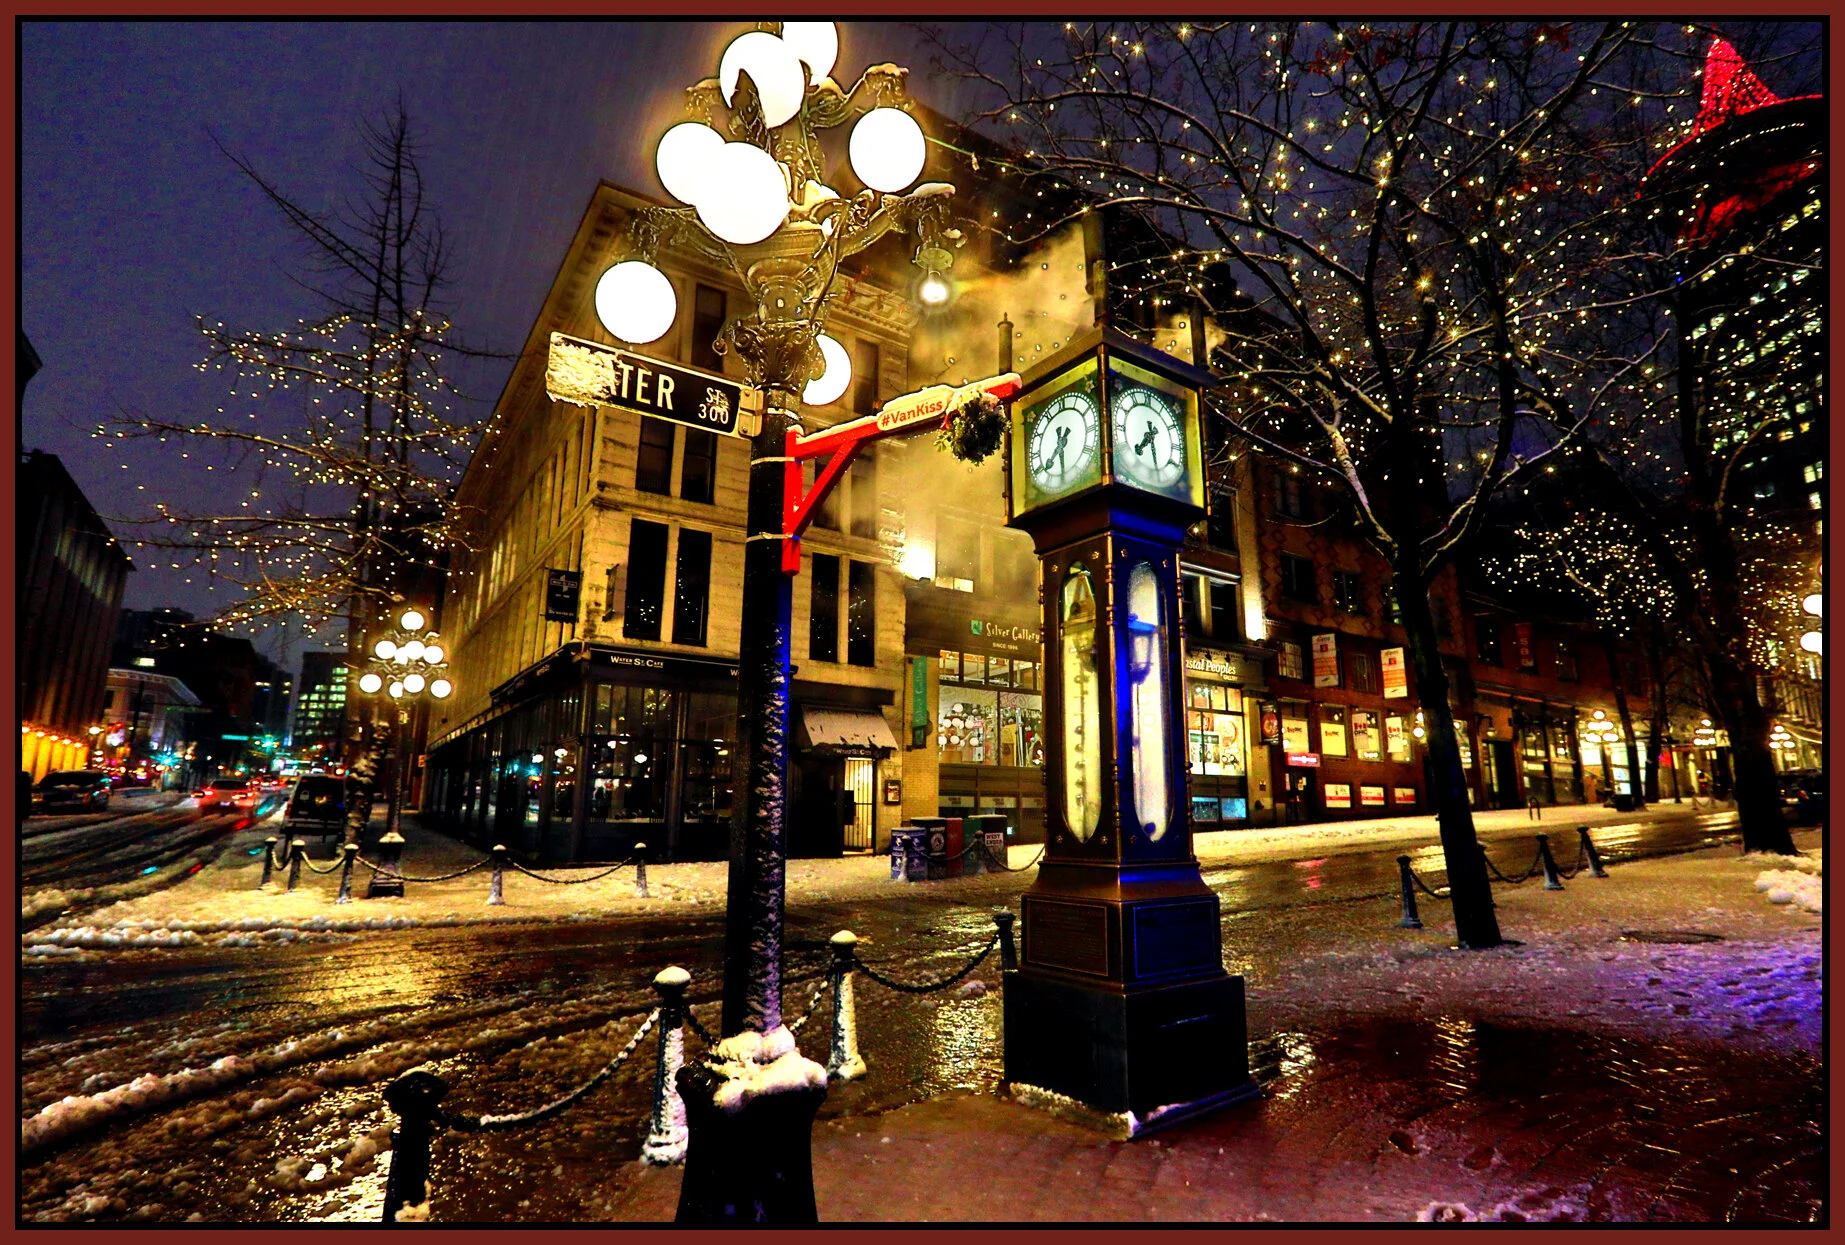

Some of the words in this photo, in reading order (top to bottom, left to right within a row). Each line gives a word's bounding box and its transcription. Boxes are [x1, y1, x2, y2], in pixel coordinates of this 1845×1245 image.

[698, 403, 729, 424] 300
[881, 401, 943, 427] #VanKiss
[986, 622, 1010, 637] Silver
[1012, 626, 1040, 644] Gallery
[1186, 659, 1205, 671] stal
[1206, 660, 1236, 676] Peoples
